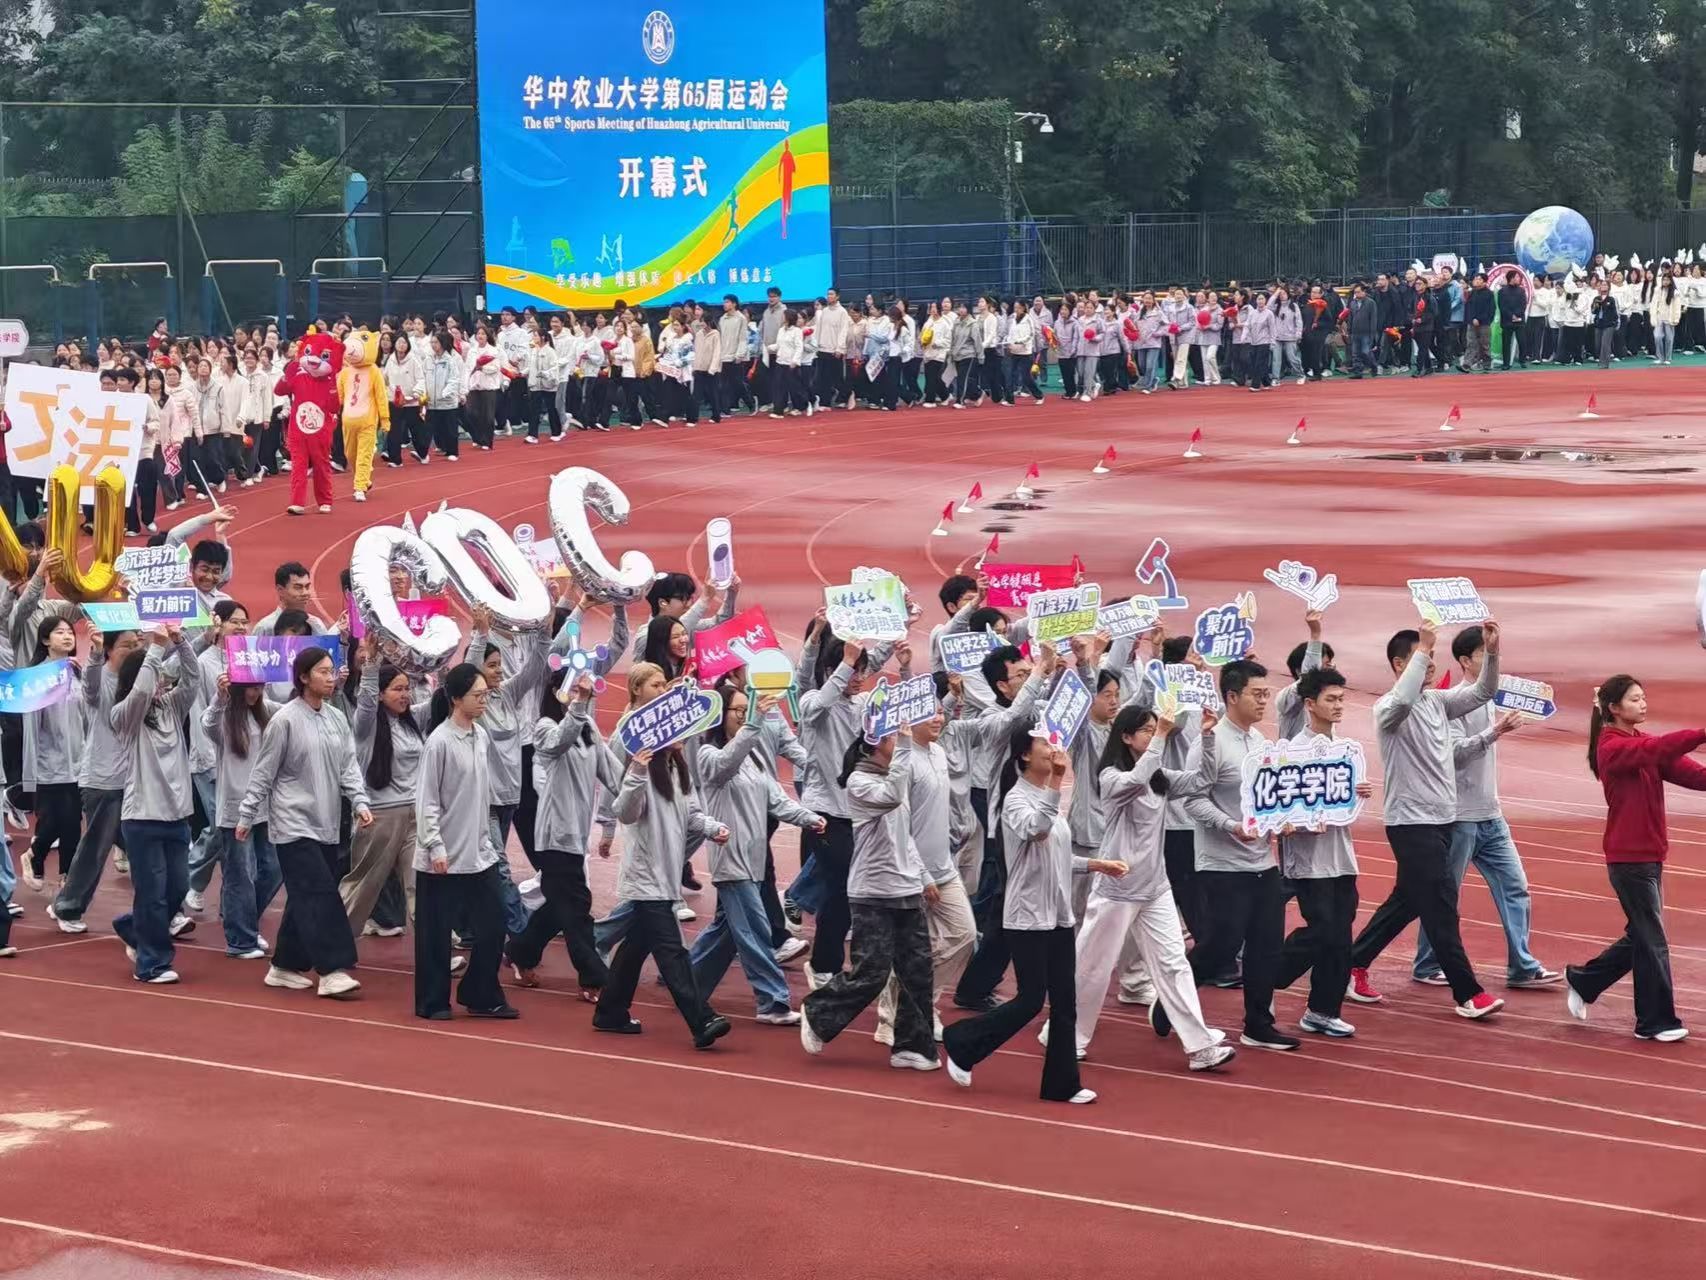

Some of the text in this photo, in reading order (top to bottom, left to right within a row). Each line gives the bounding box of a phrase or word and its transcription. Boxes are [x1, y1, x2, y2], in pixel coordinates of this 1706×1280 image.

[523, 75, 789, 110] 华中农业大学第65届运动会
[523, 115, 790, 132] The 65th Sports Meeting of Huazhong Agricultural University
[619, 156, 708, 198] 开幕式
[125, 546, 176, 570] 沉淀努力
[138, 564, 189, 585] 升华梦想
[141, 595, 192, 614] 聚力前行
[1033, 594, 1081, 617] 沉淀努力
[1204, 612, 1237, 636] 聚力
[943, 633, 989, 654] 以化学之名
[1211, 631, 1246, 657] 前行
[1168, 665, 1213, 690] 以化学之名
[628, 693, 685, 737] 化育万物
[640, 701, 707, 747] 笃行致远
[885, 694, 935, 730] 反应拉满
[1254, 764, 1352, 809] 化学学院
